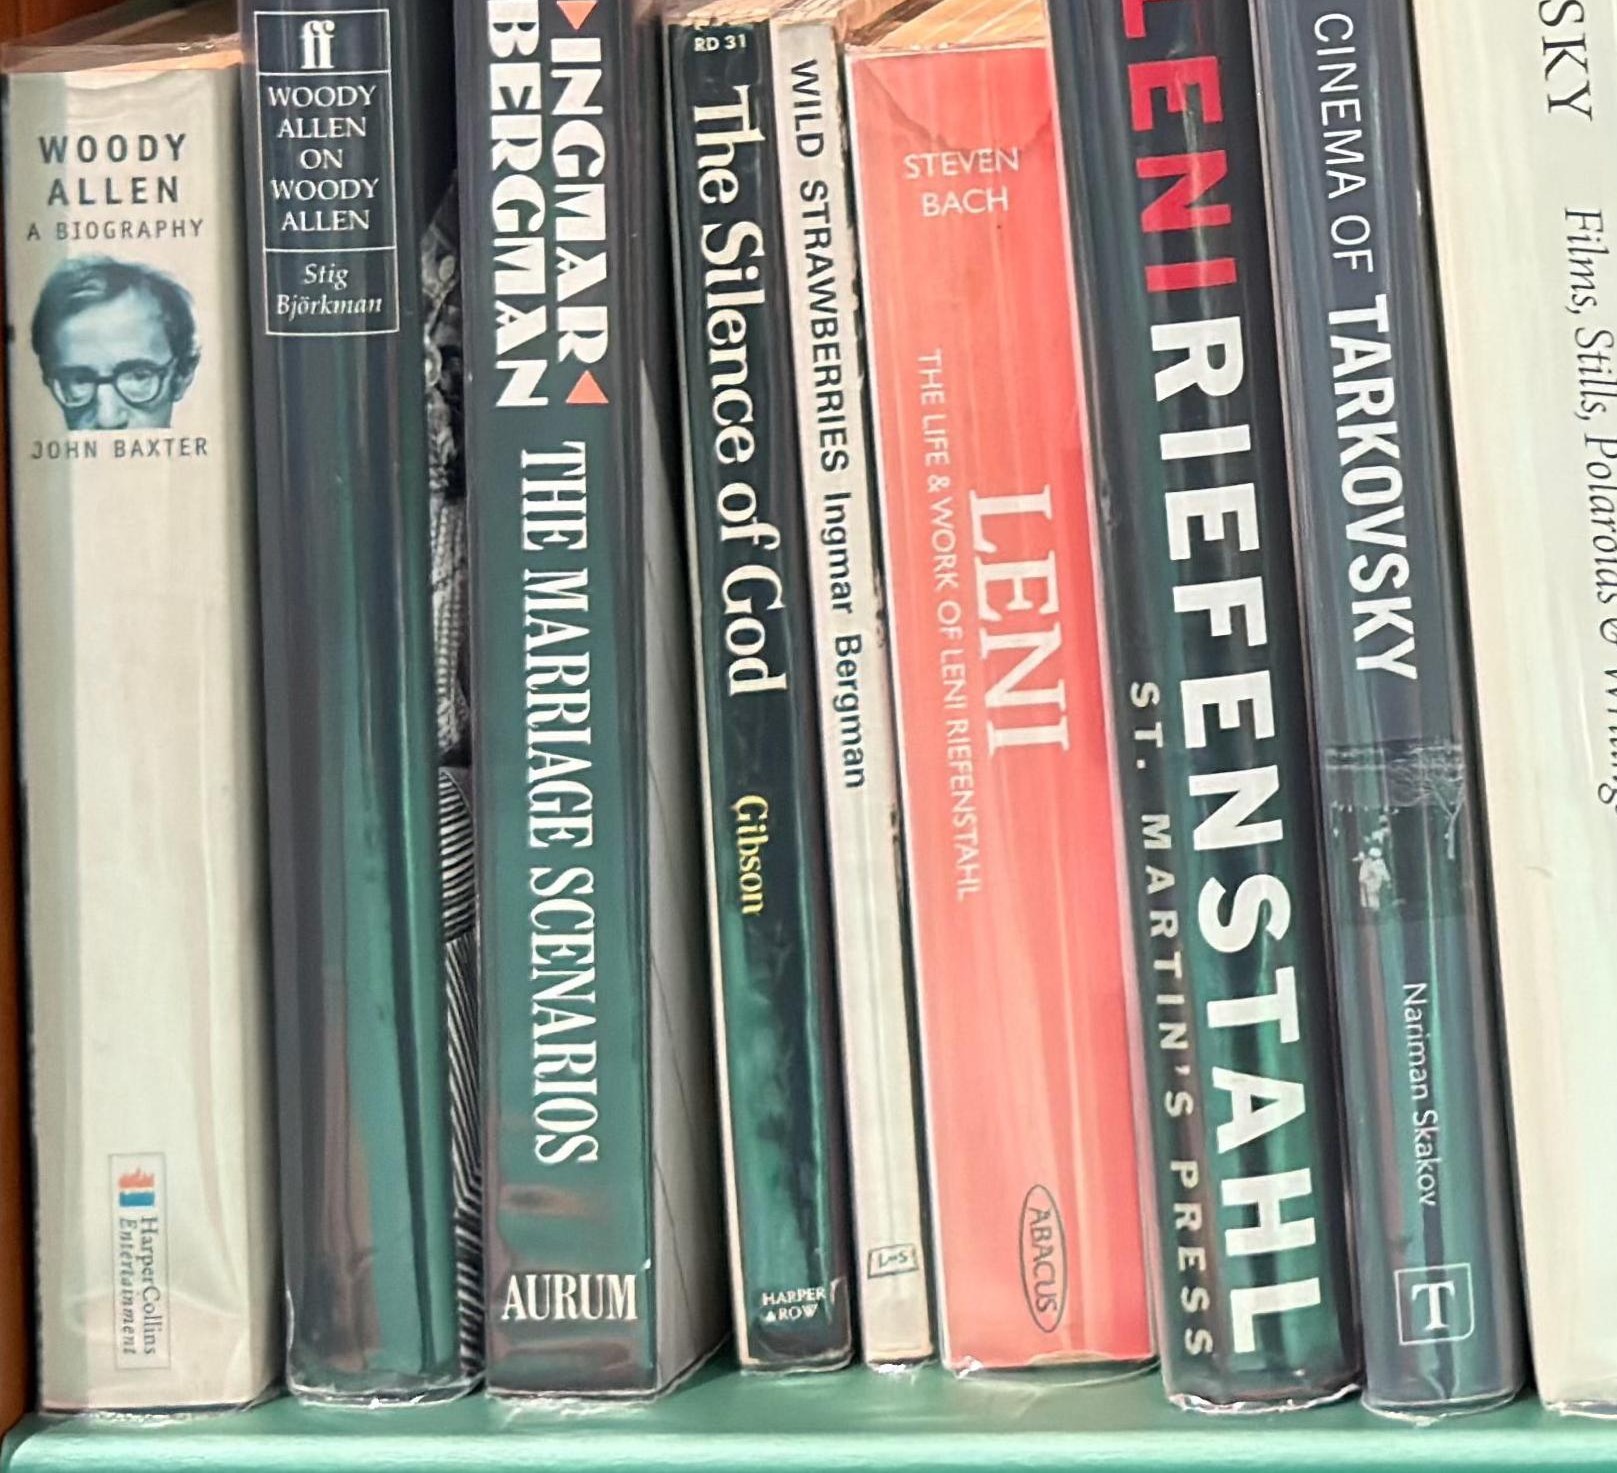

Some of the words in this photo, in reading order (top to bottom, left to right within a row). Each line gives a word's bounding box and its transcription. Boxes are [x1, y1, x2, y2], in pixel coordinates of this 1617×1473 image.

[300, 20, 335, 69] ff
[694, 37, 719, 52] RD
[724, 34, 746, 49] 31
[268, 85, 377, 107] WOODY
[277, 117, 366, 138] ALLEN
[790, 59, 824, 158] WILD
[1314, 11, 1366, 199] CINEMA
[39, 133, 186, 164] WOODY
[300, 148, 343, 169] ON
[693, 84, 765, 204] The
[904, 147, 1020, 180] STEVEN
[48, 176, 178, 206] ALLEN
[271, 178, 379, 200] WOODY
[282, 210, 370, 231] ALLEN
[550, 37, 609, 364] INGMAR
[922, 188, 1009, 217] BACH
[27, 223, 41, 241] A
[56, 218, 204, 240] BIOGRAPHY
[1331, 214, 1374, 274] OF
[1565, 206, 1610, 315] Films,
[276, 294, 382, 323] Björkman
[304, 263, 348, 290] Stig
[700, 222, 766, 464] Silence
[799, 179, 849, 473] STRAWBERRIES
[917, 350, 944, 409] THE
[31, 440, 97, 460] JOHN
[114, 437, 208, 458] BAXTER
[922, 412, 951, 469] LIFE
[520, 440, 588, 551] THE
[718, 479, 780, 550] of
[926, 471, 950, 494] &
[1329, 295, 1417, 680] TARKOVSKY
[821, 490, 852, 614] Ingmar
[930, 496, 959, 594] WORK
[721, 561, 787, 697] God
[939, 605, 964, 641] OF
[969, 484, 1069, 756] LENI
[522, 567, 594, 848] MARRIAGE
[834, 633, 866, 789] Bergman
[941, 643, 971, 712] LENI
[1129, 681, 1164, 770] ST.
[946, 719, 984, 902] RIEFENSTAHL
[730, 795, 769, 917] Gibson
[1141, 815, 1193, 1119] MARTIN'S
[528, 866, 599, 1164] SCENARIOS
[1402, 983, 1429, 1101] Nariman
[1412, 1109, 1443, 1208] Skakov
[119, 1217, 137, 1355] Entertainment
[136, 1216, 163, 1355] HarperCollins
[502, 1272, 638, 1322] AURUM
[762, 1287, 826, 1306] HARPER
[1028, 1206, 1058, 1315] ABACUS
[1170, 1159, 1214, 1356] PRESS
[778, 1304, 818, 1321] ROW
[1411, 1281, 1455, 1330] T
